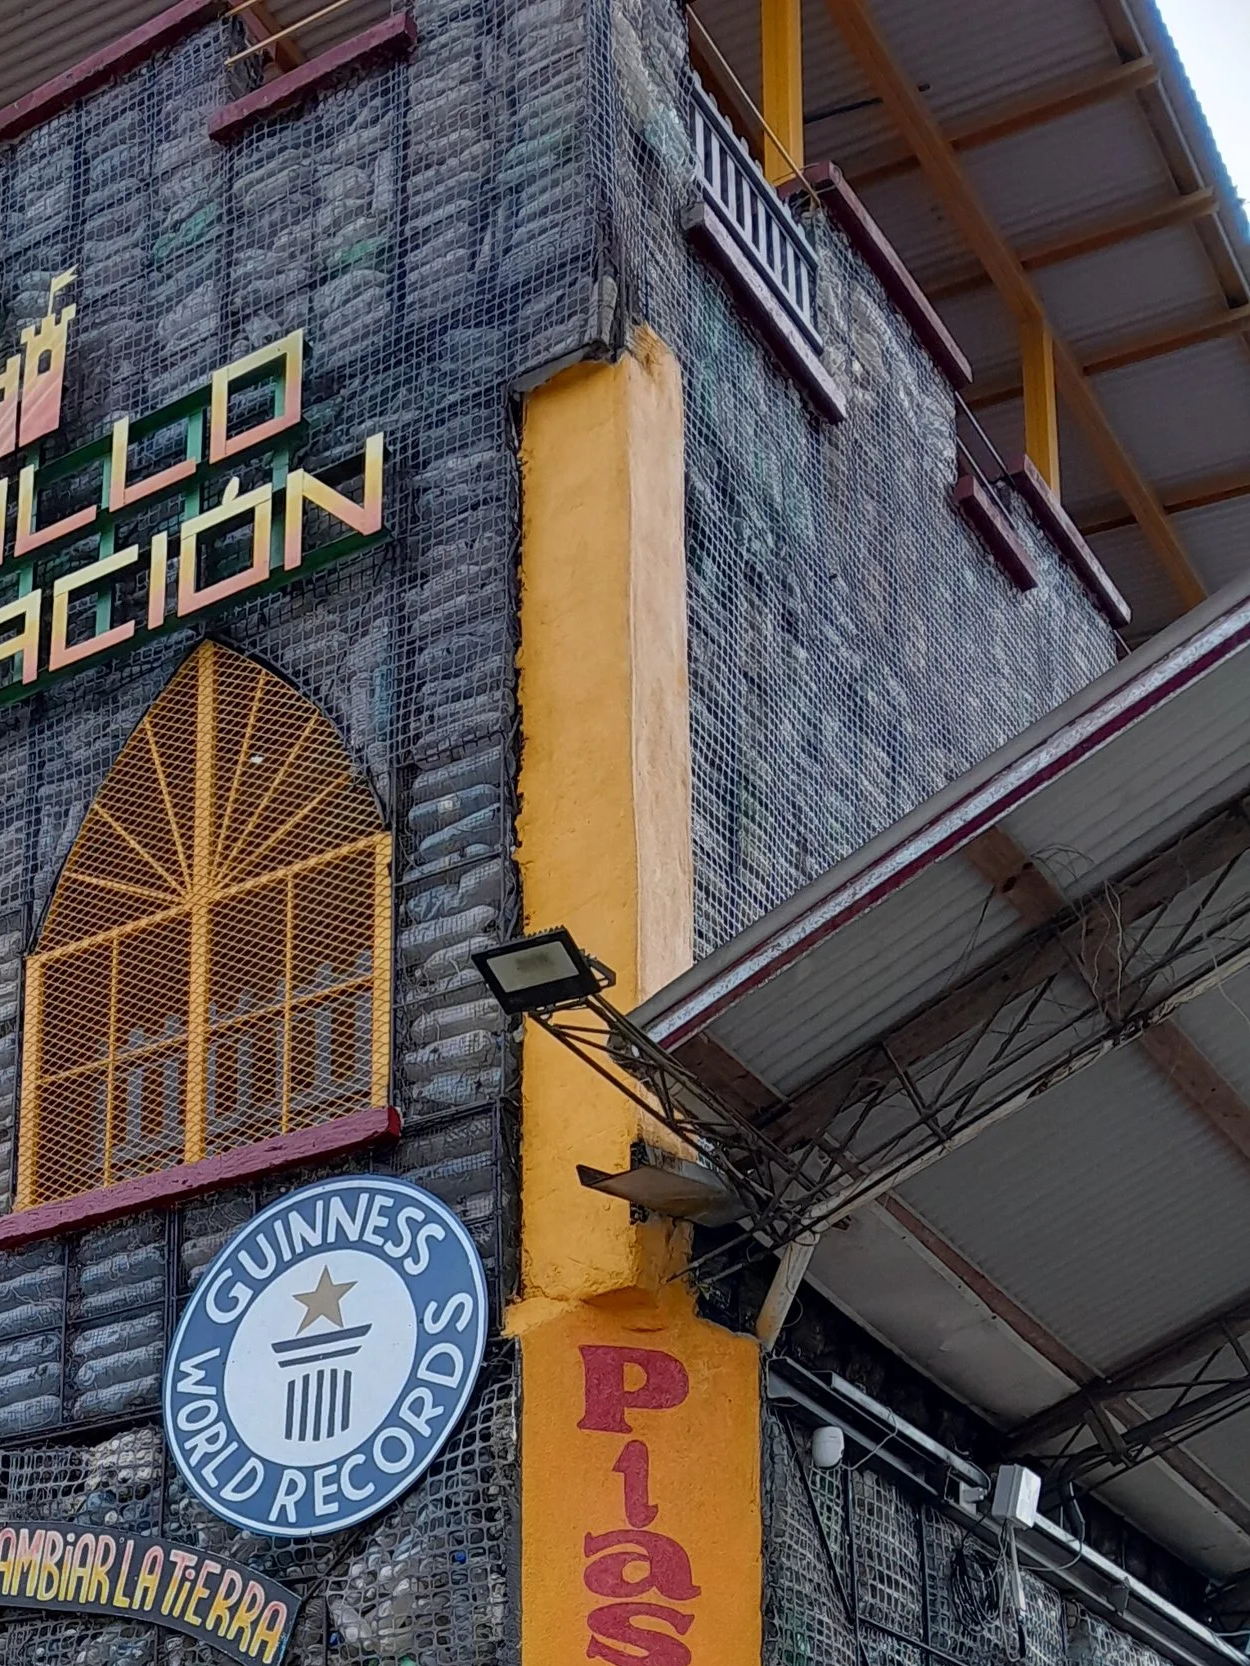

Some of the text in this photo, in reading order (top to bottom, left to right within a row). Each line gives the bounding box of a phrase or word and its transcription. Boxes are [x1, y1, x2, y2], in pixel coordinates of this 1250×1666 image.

[205, 1192, 446, 1325] GUINNESS
[176, 1292, 474, 1524] WORLD RECORDS
[112, 1538, 164, 1611] LA
